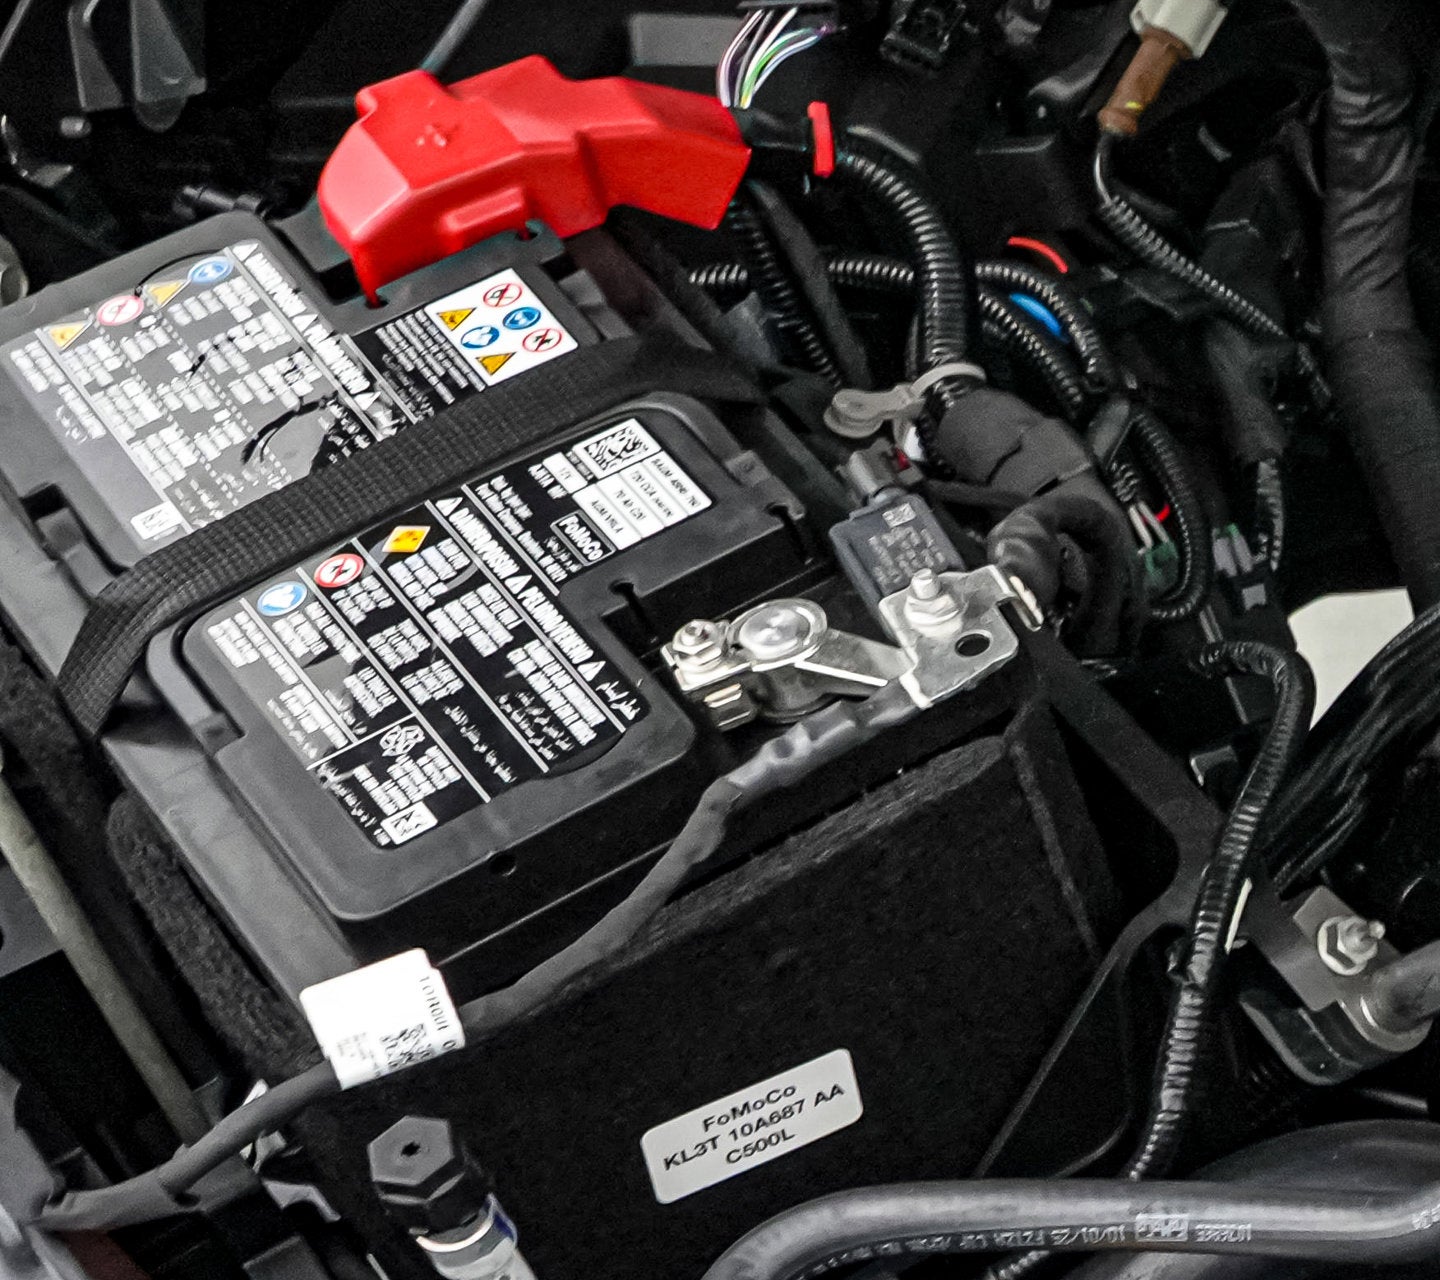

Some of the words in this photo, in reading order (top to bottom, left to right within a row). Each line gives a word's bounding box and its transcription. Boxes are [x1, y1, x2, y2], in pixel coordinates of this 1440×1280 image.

[558, 515, 604, 562] FoMoCo
[663, 1134, 721, 1171] KL3T
[728, 1099, 806, 1142] 10A687
[814, 1083, 845, 1108] AA
[702, 1085, 797, 1132] FoMoCo
[726, 1128, 796, 1165] C500L
